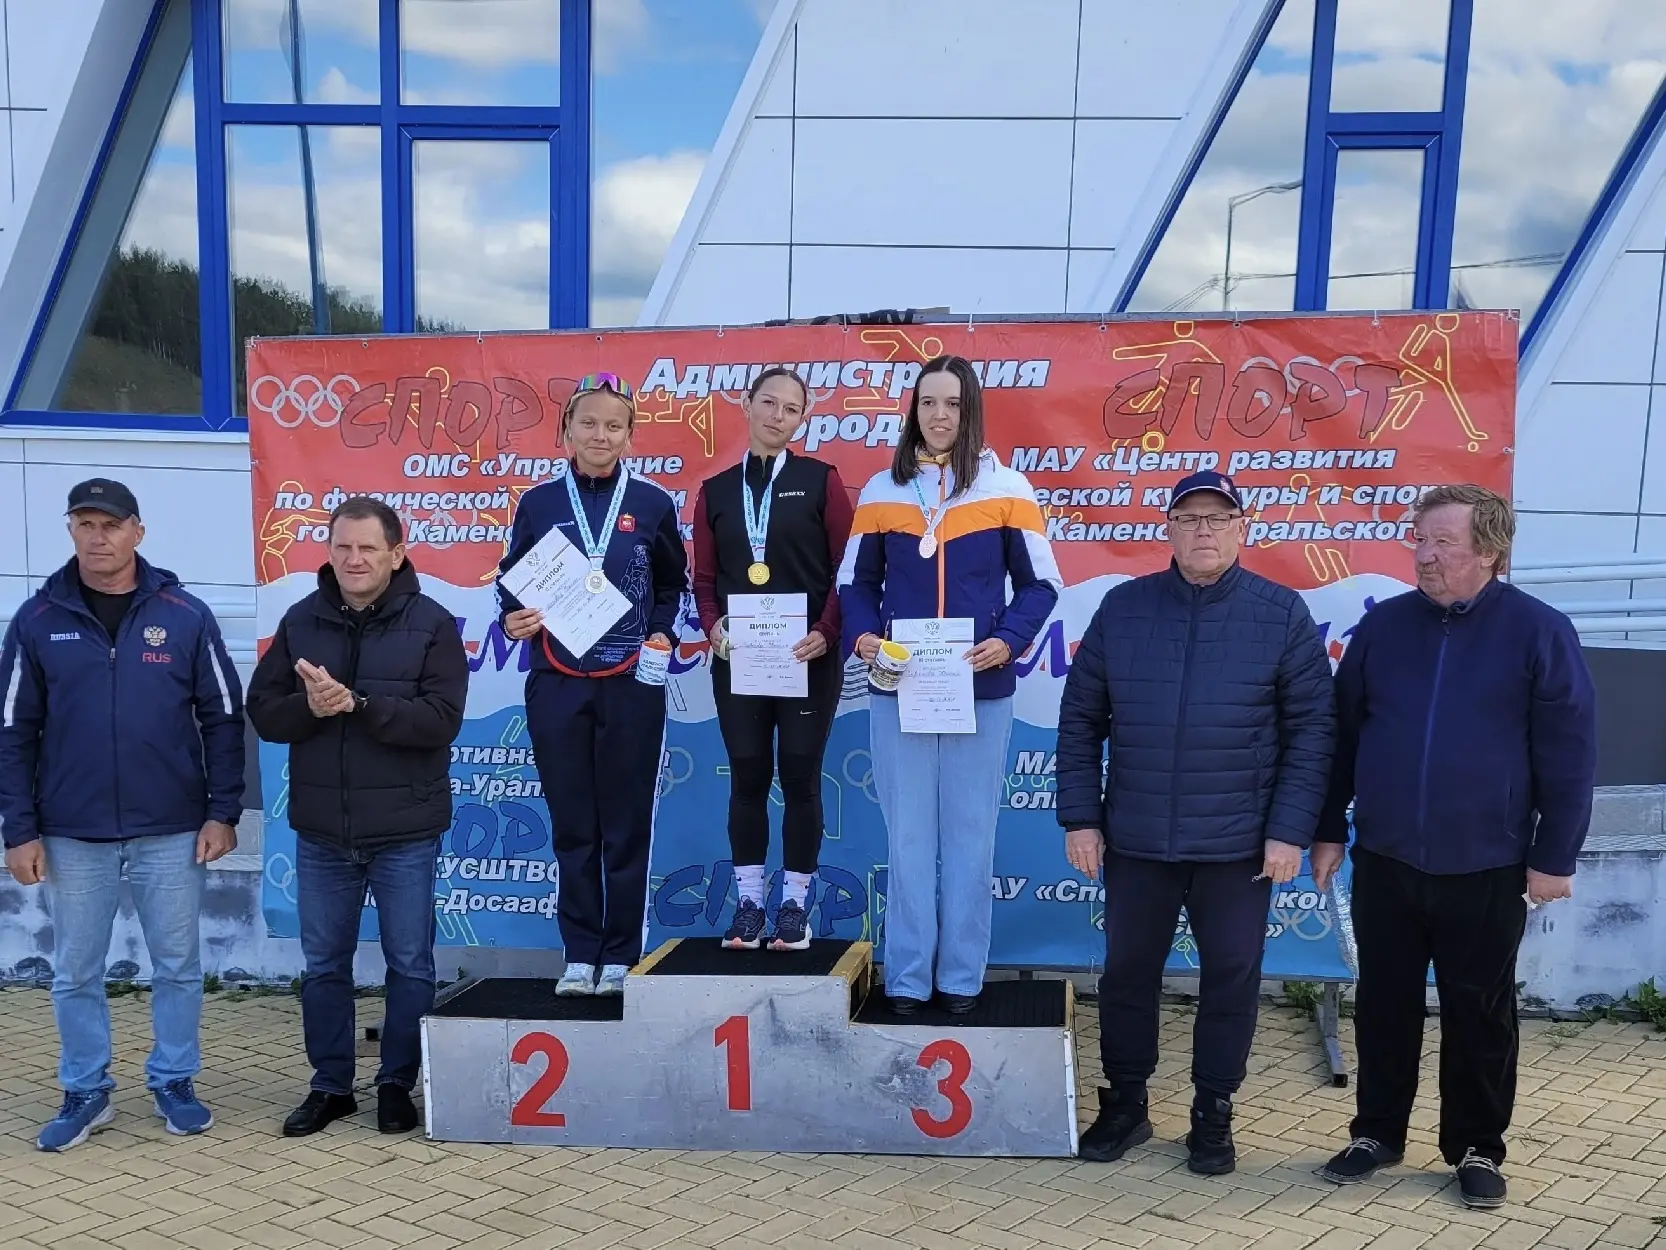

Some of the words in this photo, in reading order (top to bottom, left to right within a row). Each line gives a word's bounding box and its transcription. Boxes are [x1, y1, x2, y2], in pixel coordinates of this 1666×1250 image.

[1103, 361, 1403, 442] СПОРТ
[402, 453, 471, 477] ОМС
[1011, 447, 1086, 473] МАУ
[1092, 447, 1219, 476] «Центр
[1227, 448, 1397, 476] развития
[274, 491, 314, 510] по
[1319, 487, 1342, 505] и
[535, 561, 566, 592] ДИПЛОМ
[49, 631, 81, 640] RUSSIA
[749, 622, 788, 631] ДИПЛОМ
[142, 652, 172, 663] RUS
[912, 647, 953, 656] ДИПЛОМ
[714, 1015, 751, 1110] 1
[510, 1031, 569, 1127] 2
[910, 1038, 973, 1139] 3
